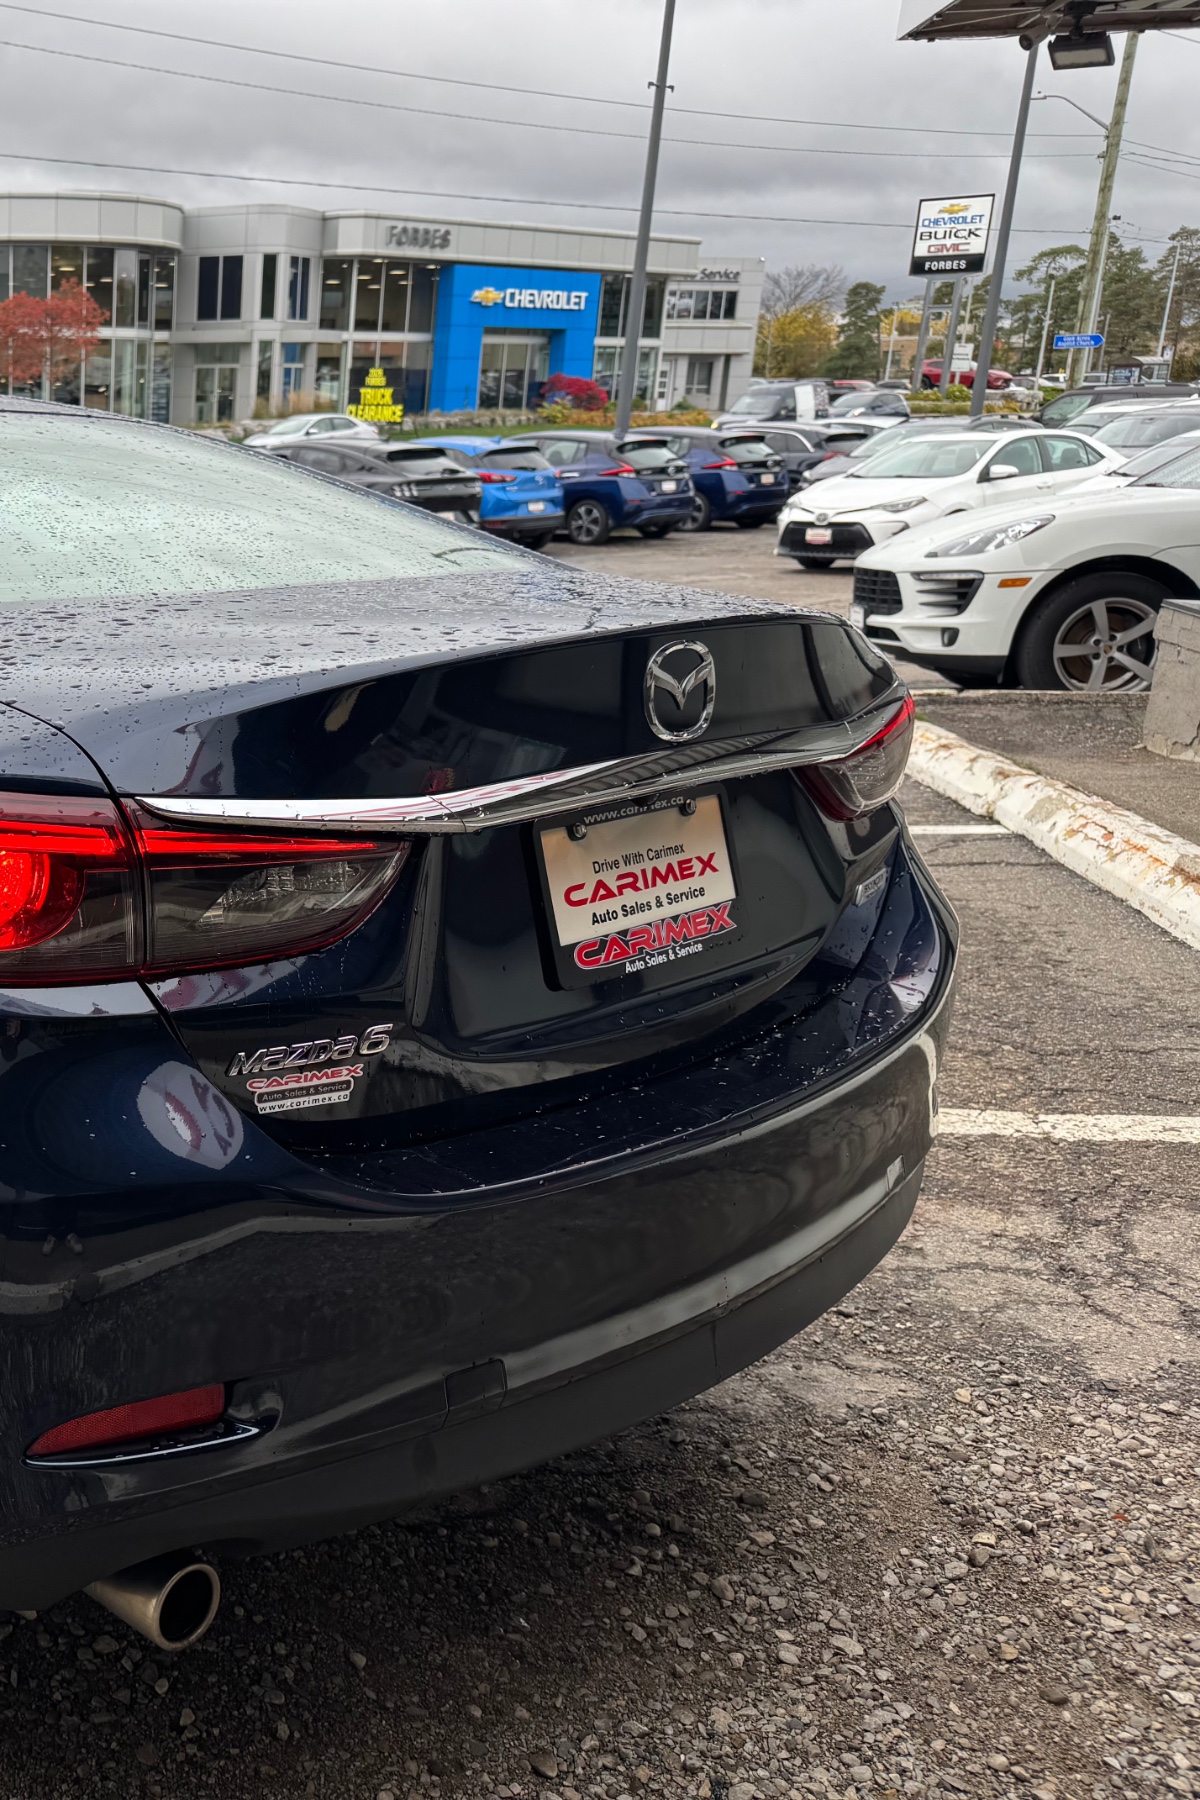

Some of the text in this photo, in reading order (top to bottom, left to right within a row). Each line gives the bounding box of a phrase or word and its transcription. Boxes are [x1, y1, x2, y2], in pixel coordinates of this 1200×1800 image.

[921, 214, 985, 227] CHEVROLET
[386, 225, 451, 249] FORBES
[919, 228, 983, 241] BUICK
[927, 242, 971, 254] GMC
[700, 267, 741, 280] Service
[924, 260, 967, 271] FORBES
[504, 288, 589, 310] CHEVROLET
[360, 387, 394, 405] TRUCK
[346, 405, 404, 423] CLEARANCE
[592, 843, 685, 874] Drive With Carimex
[563, 852, 719, 908] CARIMEX
[591, 886, 706, 925] Auto Sales & Service
[575, 903, 736, 969] CARIMEX
[625, 943, 703, 973] Auto Sales & Service
[248, 1065, 362, 1090] CARIMEX
[262, 1092, 282, 1101] Auto
[284, 1089, 307, 1098] Sales
[318, 1083, 347, 1093] Service
[259, 1093, 349, 1112] www.carimex.ca
